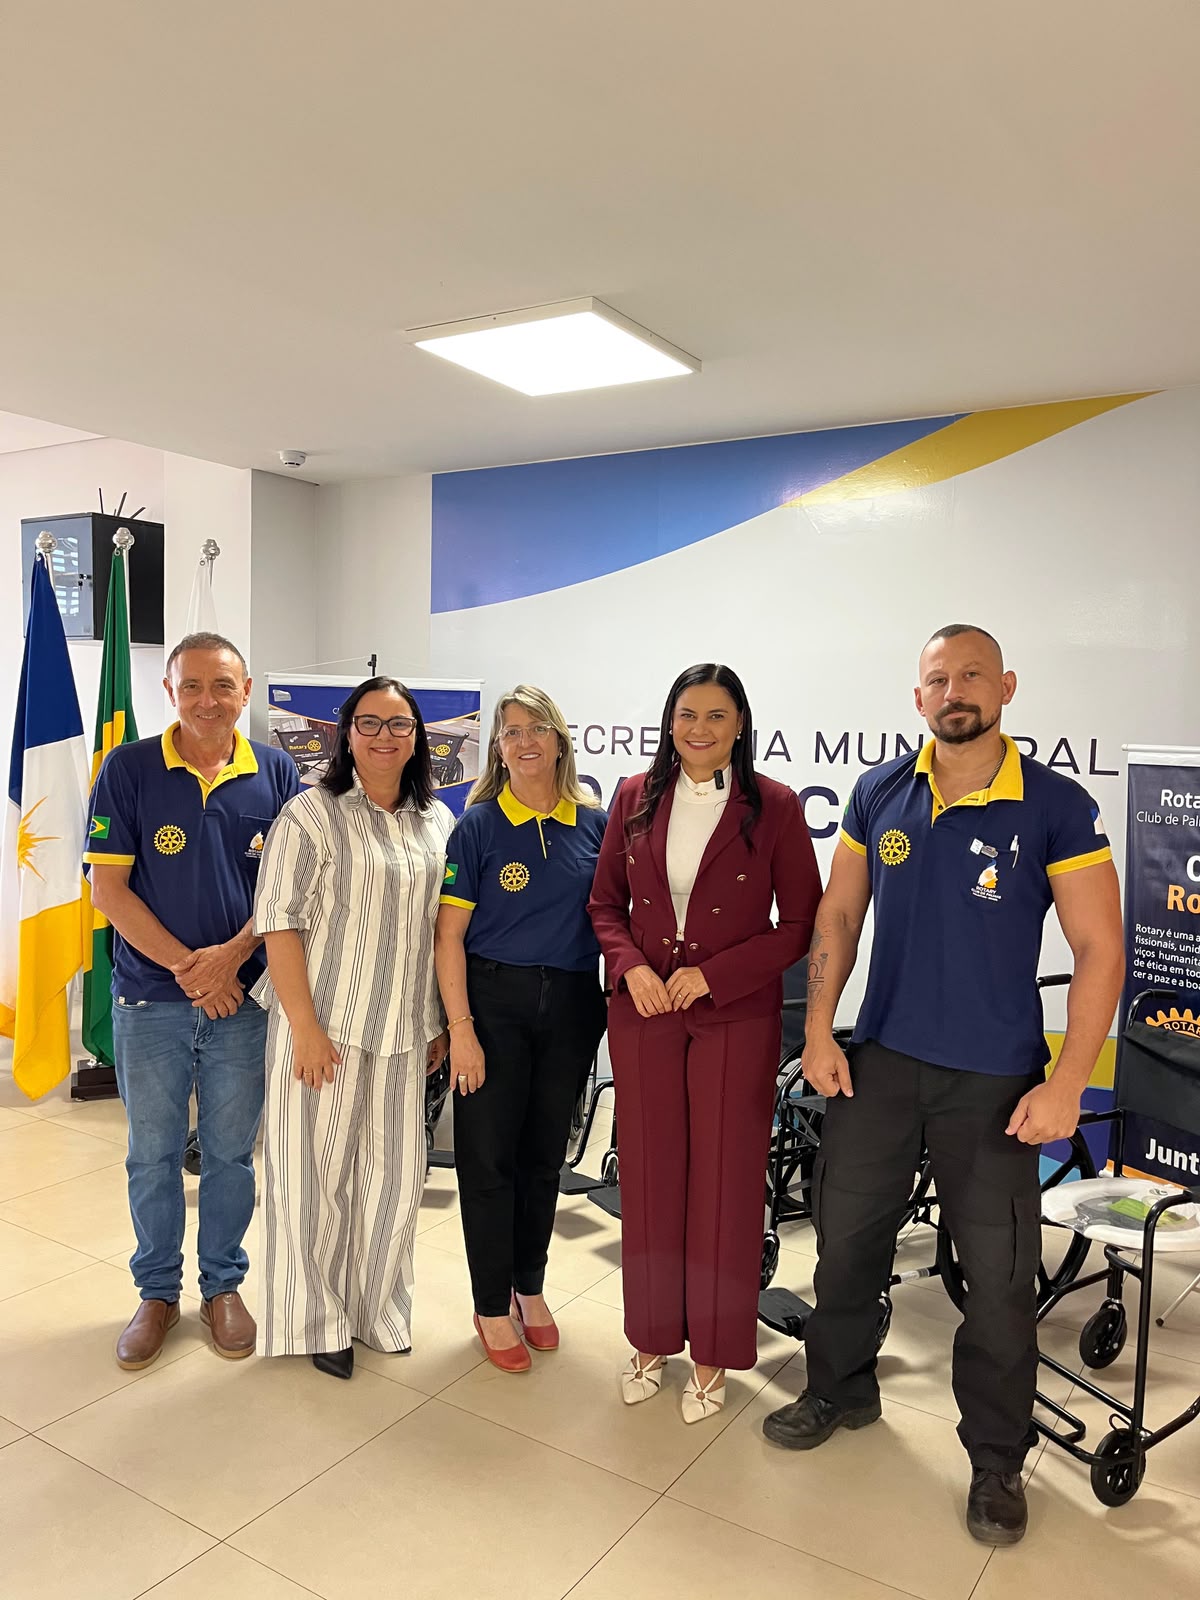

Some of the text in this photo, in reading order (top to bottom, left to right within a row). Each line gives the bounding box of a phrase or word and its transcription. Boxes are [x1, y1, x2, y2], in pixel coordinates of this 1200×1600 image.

[815, 731, 1119, 776] MUNPAL
[1137, 811, 1200, 827] Club de Pal
[1167, 884, 1200, 914] Ro
[1135, 923, 1165, 938] Rotary
[1166, 929, 1172, 938] é
[1173, 931, 1194, 941] uma
[1135, 934, 1177, 952] fissionais,
[1134, 946, 1156, 959] viços
[1133, 957, 1145, 967] de
[1146, 960, 1168, 972] ética
[1169, 966, 1184, 975] em
[1133, 970, 1200, 991] cer a paz e a bo
[1145, 1138, 1200, 1176] Junt
